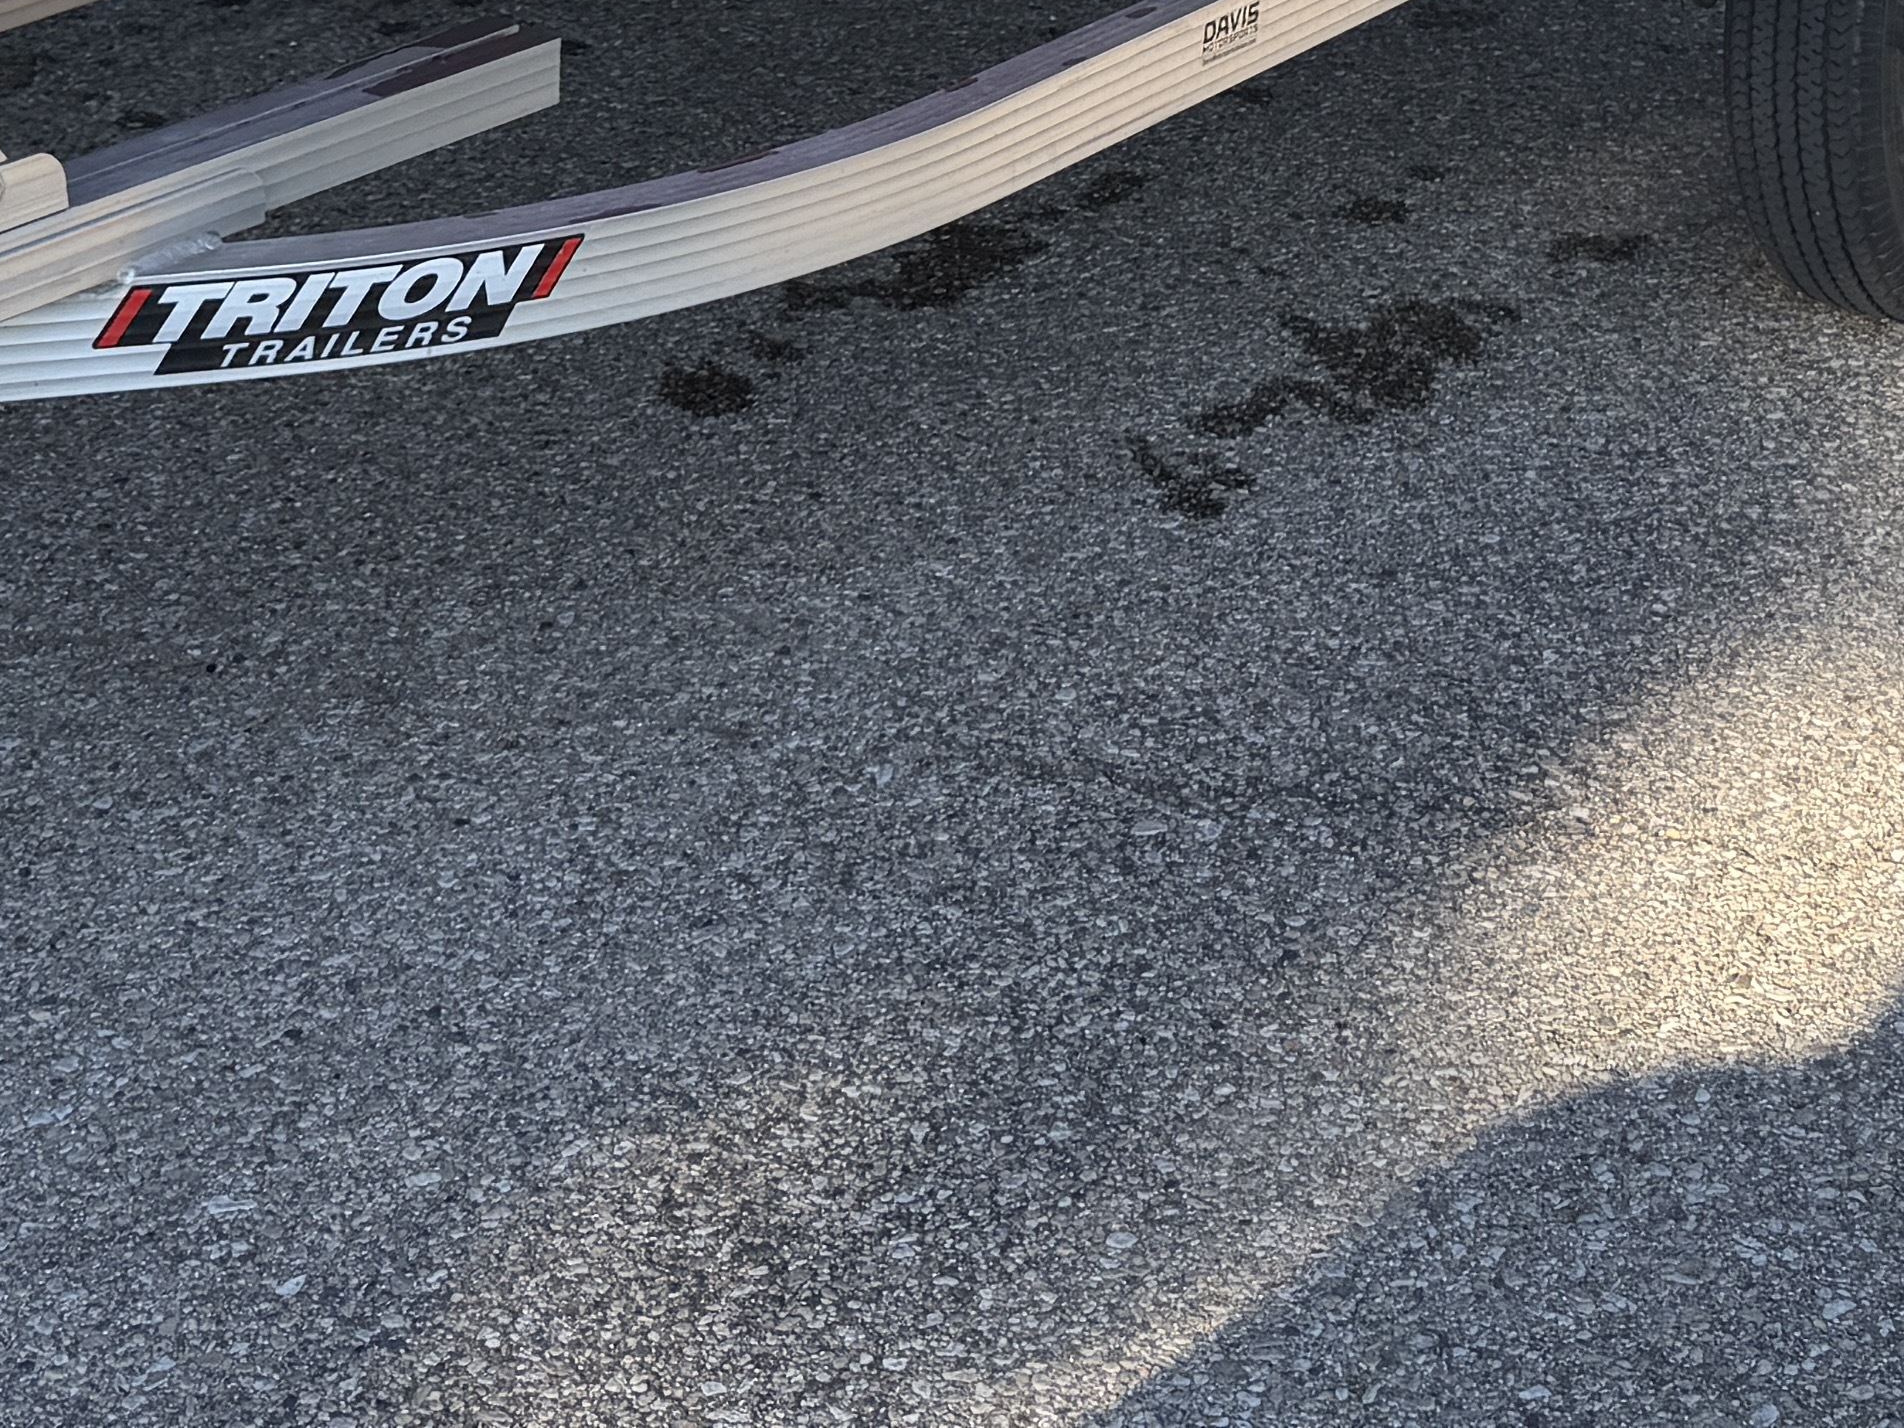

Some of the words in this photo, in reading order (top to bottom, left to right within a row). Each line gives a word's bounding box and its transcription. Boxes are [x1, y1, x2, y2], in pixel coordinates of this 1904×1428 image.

[1203, 1, 1260, 44] DAVIS
[152, 243, 545, 344] TRITON
[220, 315, 474, 368] TRAILERS
